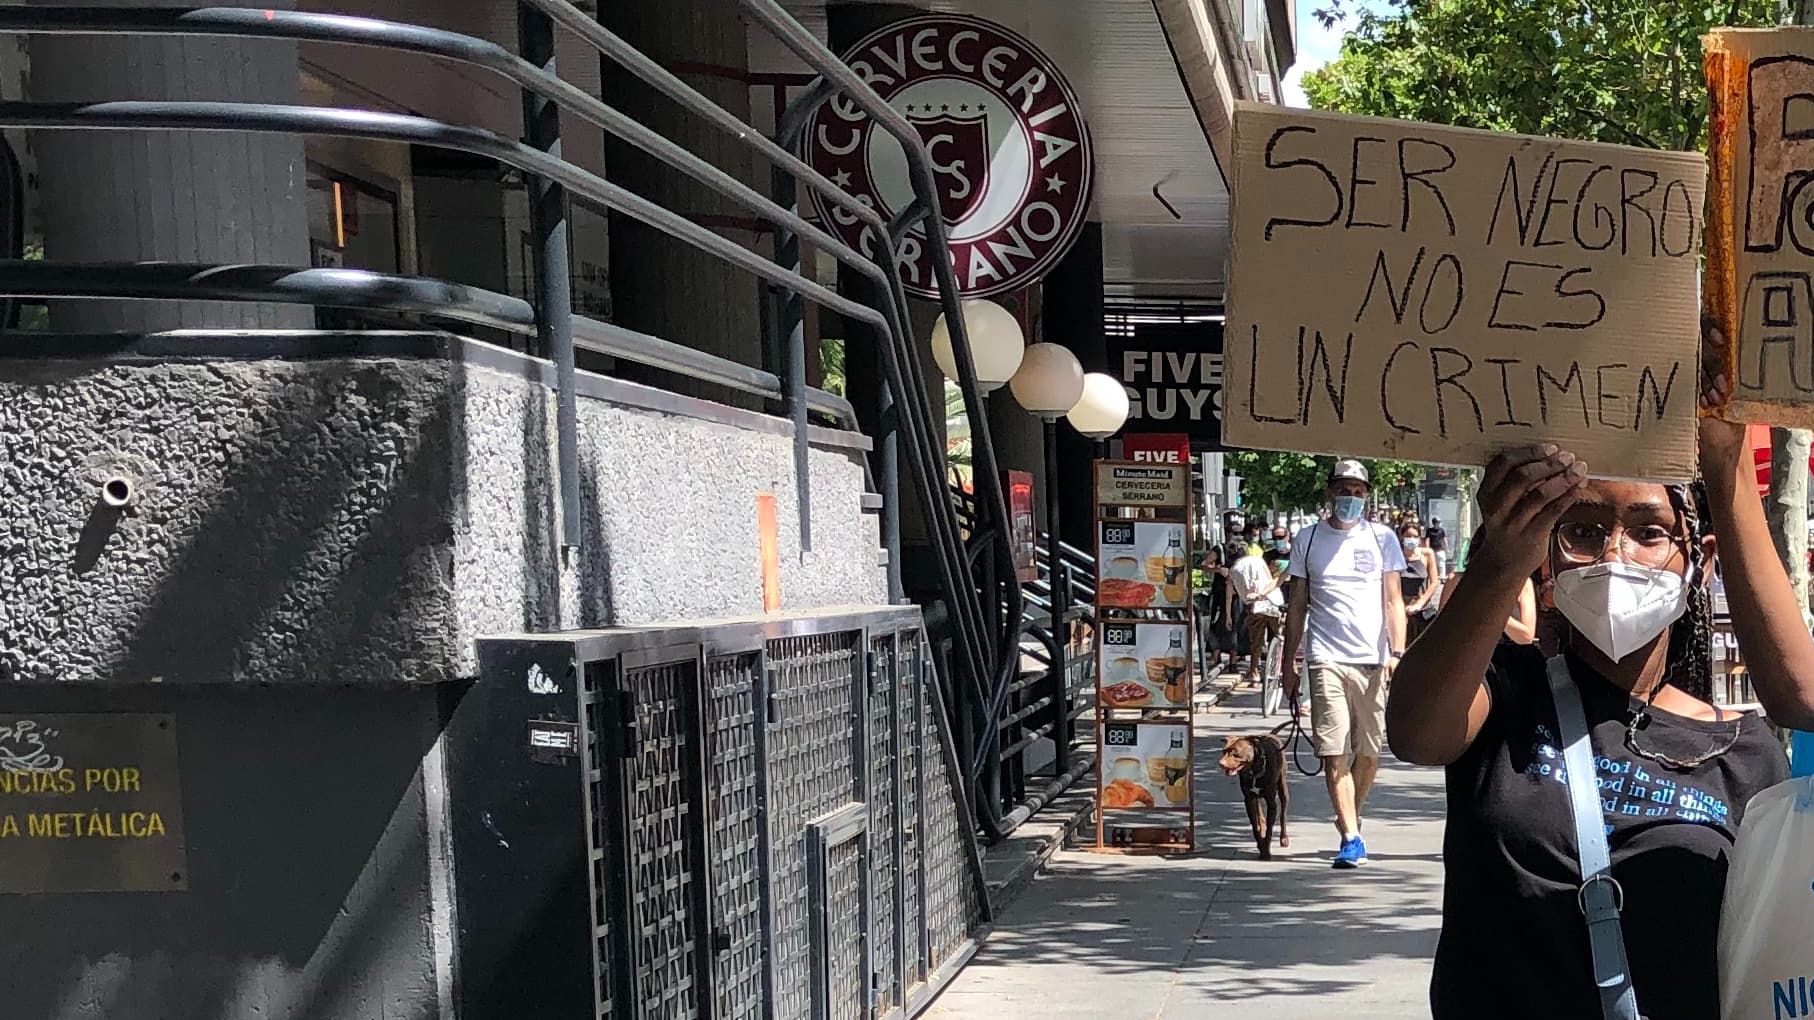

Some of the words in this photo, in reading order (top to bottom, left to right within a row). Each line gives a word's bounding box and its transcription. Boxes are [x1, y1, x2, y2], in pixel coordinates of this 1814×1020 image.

[818, 28, 1078, 169] CERVECERIA
[1265, 126, 1457, 242] SER
[1487, 151, 1695, 257] NEGRO
[832, 193, 1061, 291] SRANO
[1355, 247, 1463, 334] NO
[1488, 260, 1606, 331] ES
[1123, 351, 1223, 384] FIVE
[1250, 324, 1353, 426] UN
[1380, 341, 1680, 438] CRIMEN
[1134, 451, 1180, 463] FIVE
[1115, 481, 1171, 491] CERVECERIA
[1122, 492, 1165, 501] SERRANO
[85, 768, 141, 792] POR
[1596, 777, 1625, 793] ood
[1628, 781, 1646, 799] in
[1651, 789, 1675, 805] all
[28, 808, 166, 838] METÁLICA
[1622, 801, 1641, 816] in
